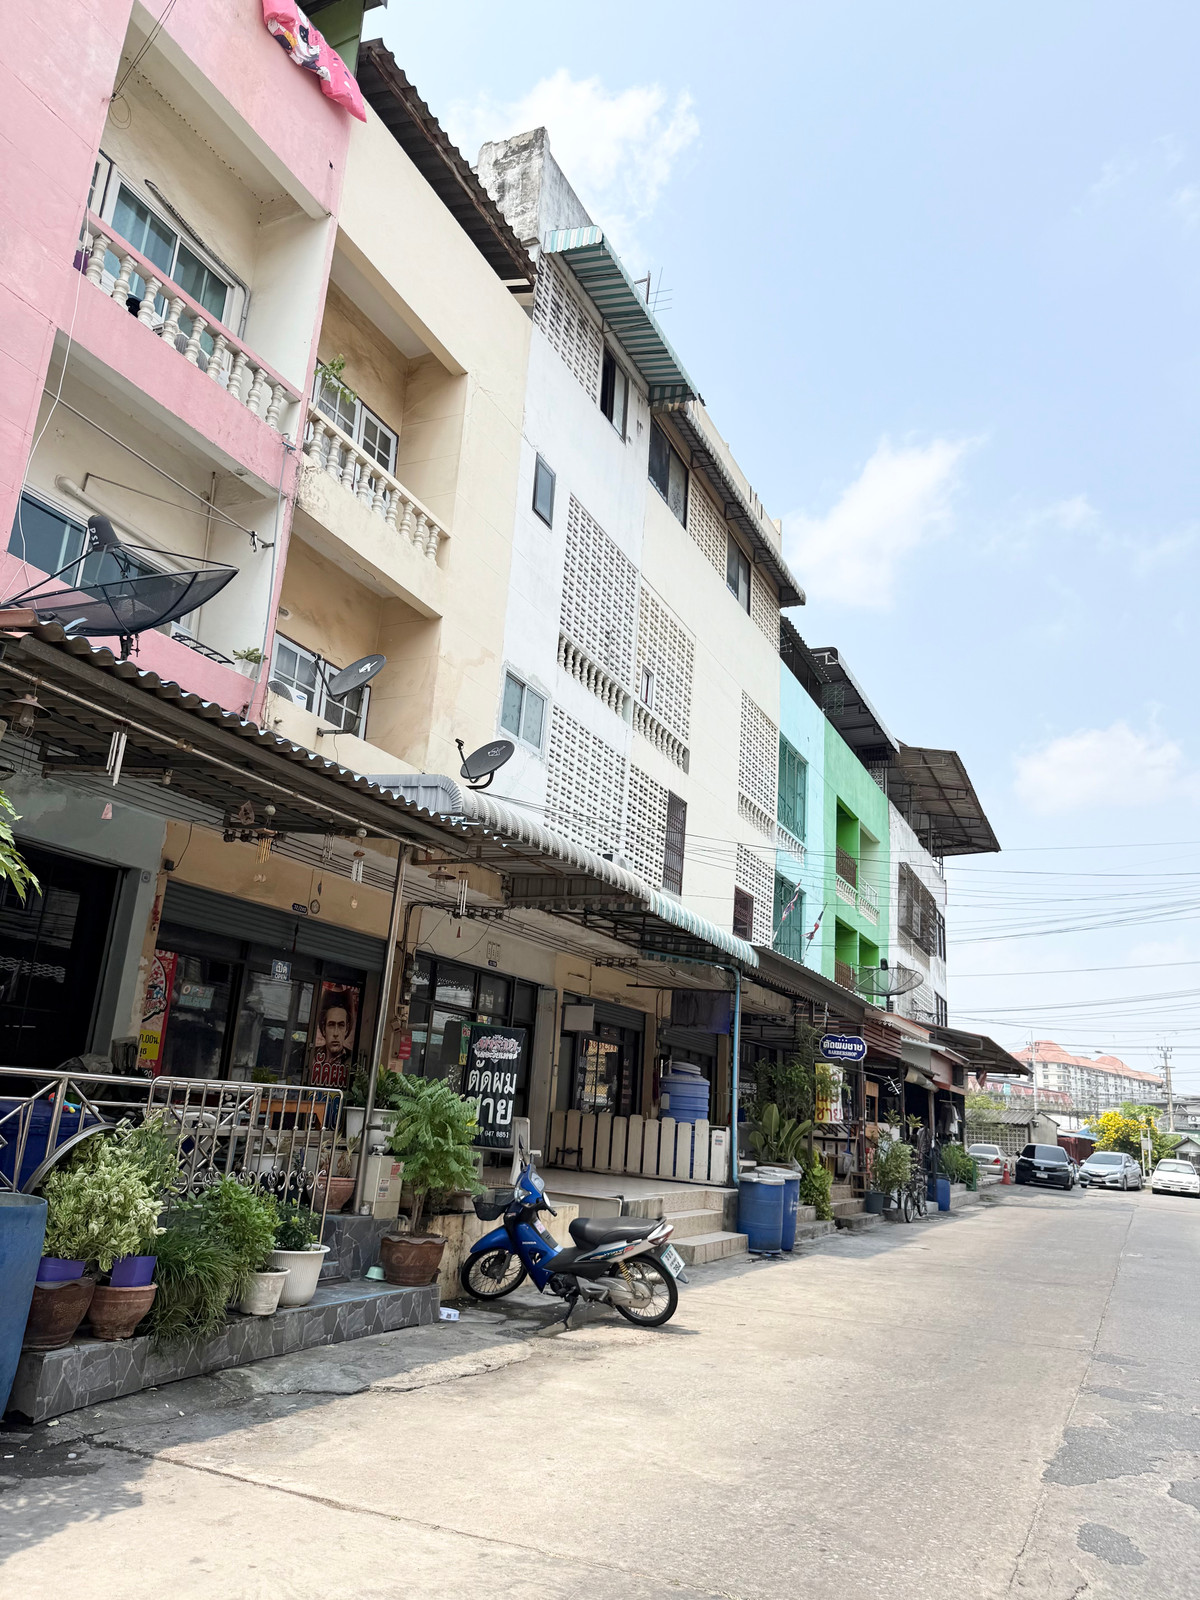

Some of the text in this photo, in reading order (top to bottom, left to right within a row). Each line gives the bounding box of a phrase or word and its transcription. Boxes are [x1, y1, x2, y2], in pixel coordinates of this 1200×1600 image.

[90, 527, 99, 545] PSI
[274, 973, 288, 981] OPEN
[823, 1040, 863, 1051] ตัดผมชาย
[310, 1052, 349, 1088] ตัดผม
[467, 1060, 517, 1095] ตัดผม
[816, 1107, 842, 1122] ชาย
